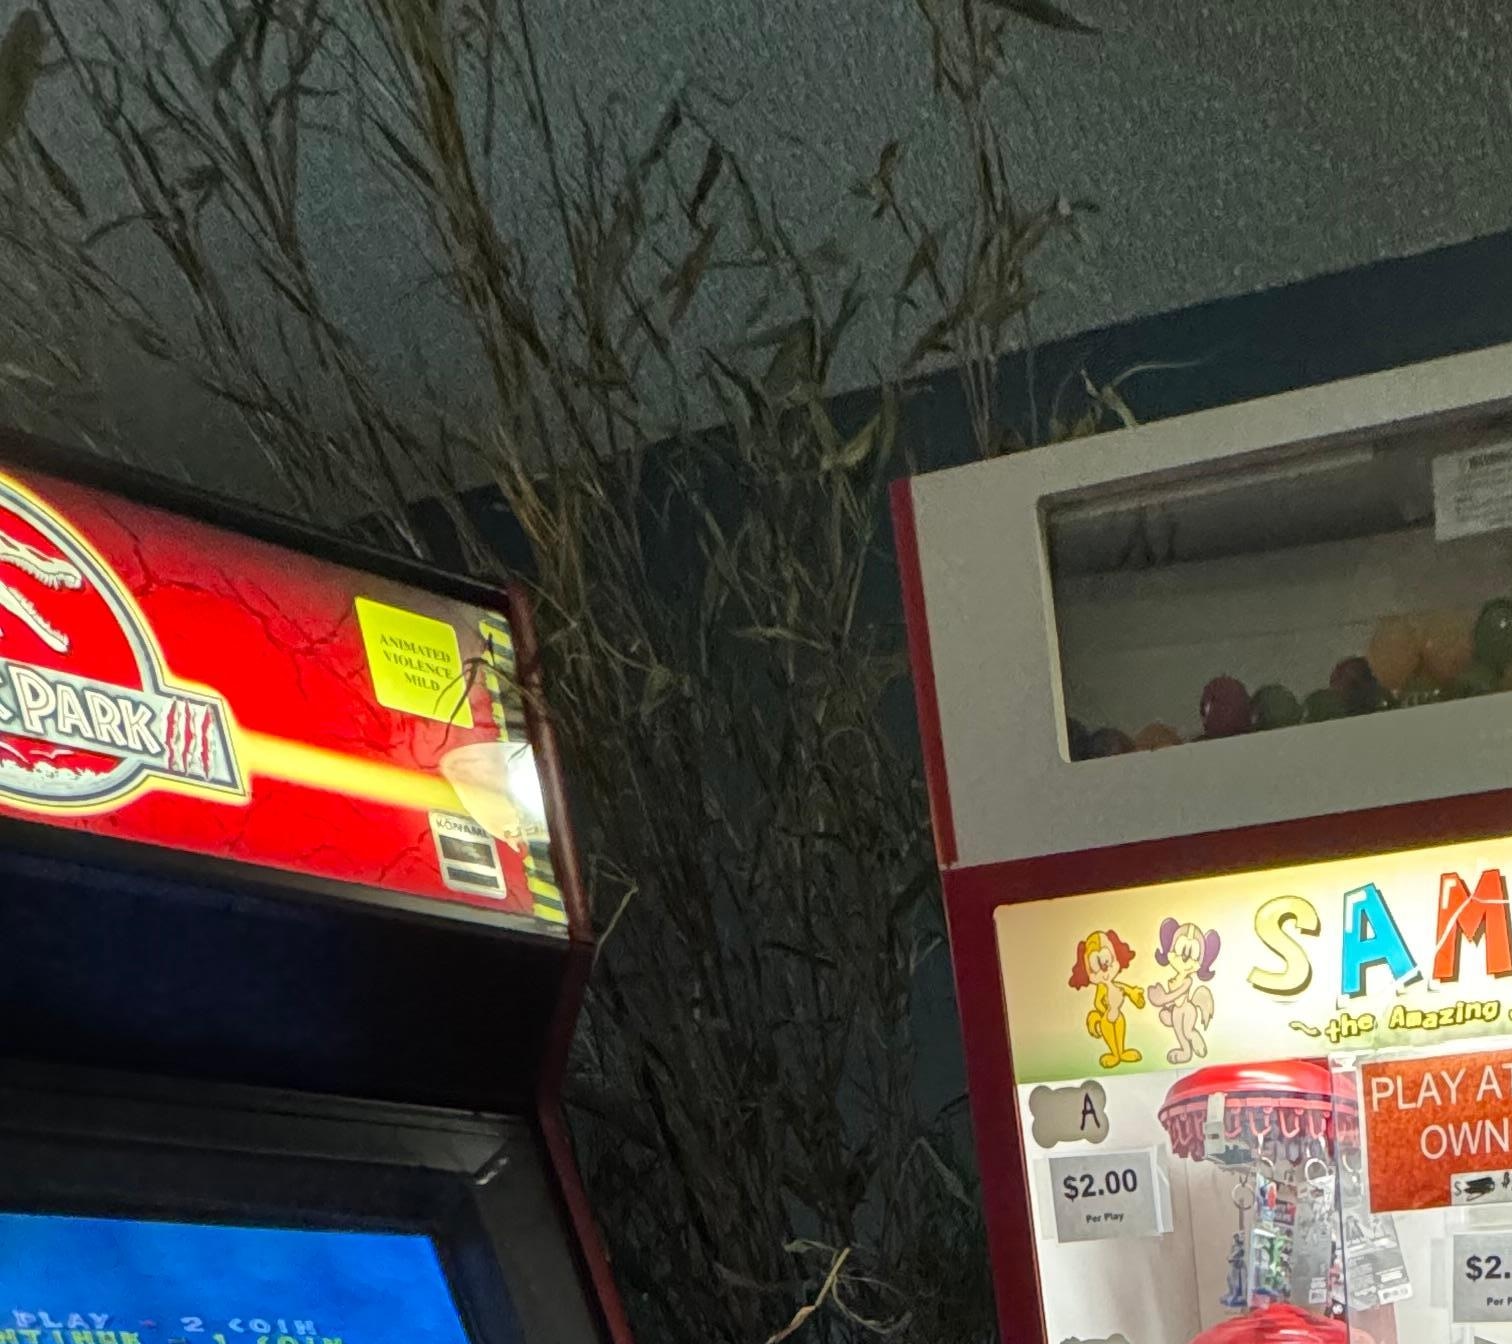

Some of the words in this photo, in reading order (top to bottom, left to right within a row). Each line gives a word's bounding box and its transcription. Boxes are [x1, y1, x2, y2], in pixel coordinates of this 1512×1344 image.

[381, 635, 451, 663] ANIMATED
[383, 650, 455, 680] VIOLENCE
[404, 672, 441, 691] MILD
[8, 663, 163, 755] PARK
[1325, 1011, 1375, 1043] the
[1388, 998, 1500, 1032] Amazing
[1371, 1066, 1466, 1113] PLAY
[1080, 1093, 1101, 1131] A
[1420, 1117, 1510, 1160] OWN
[1063, 1168, 1138, 1202] $2.00
[1086, 1213, 1102, 1224] Per
[1104, 1212, 1125, 1224] Play
[1486, 1297, 1504, 1307] Per
[13, 1309, 109, 1331] PLAY
[180, 1316, 205, 1333] 2
[229, 1317, 317, 1336] COIN
